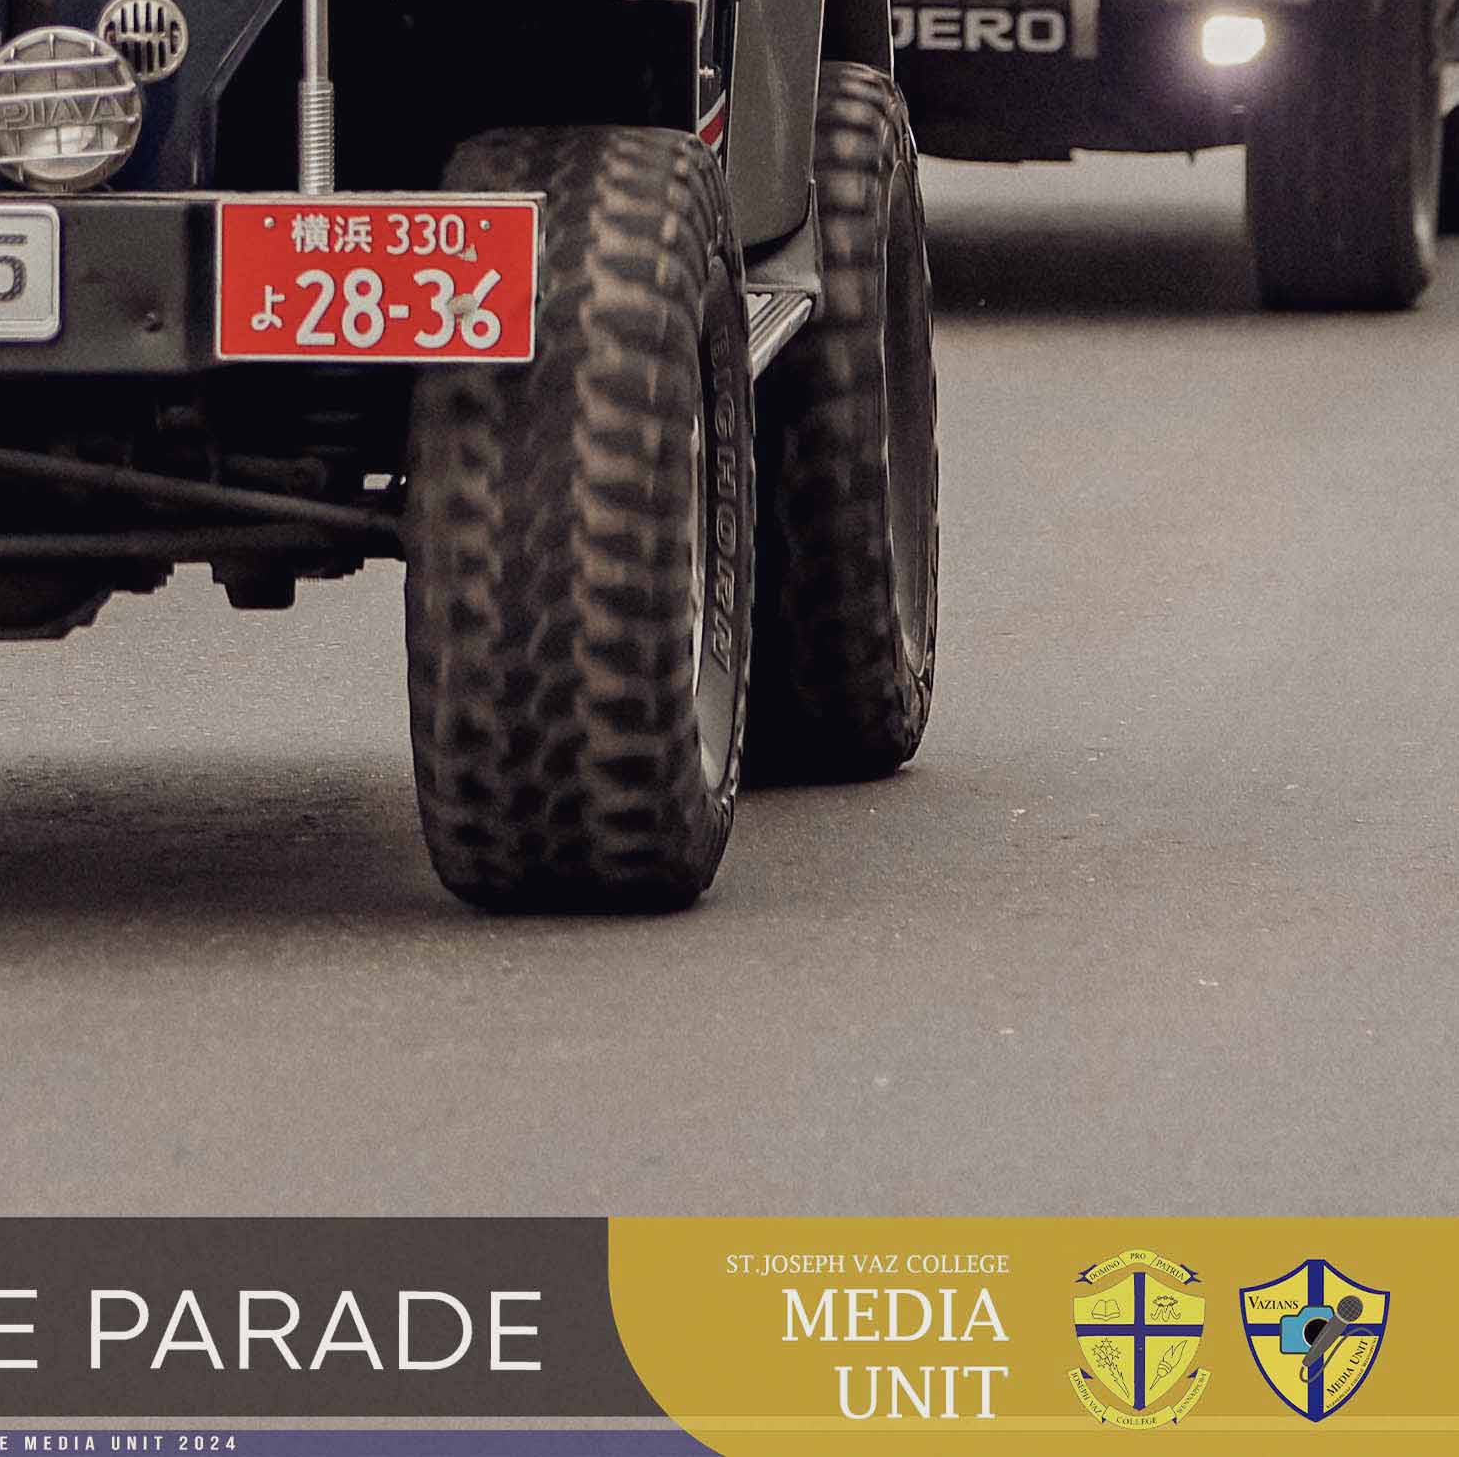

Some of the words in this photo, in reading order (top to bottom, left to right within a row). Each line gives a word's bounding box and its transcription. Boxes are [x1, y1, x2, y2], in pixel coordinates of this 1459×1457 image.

[291, 213, 373, 254] 横浜
[387, 213, 466, 256] 330
[295, 267, 502, 350] 28-36
